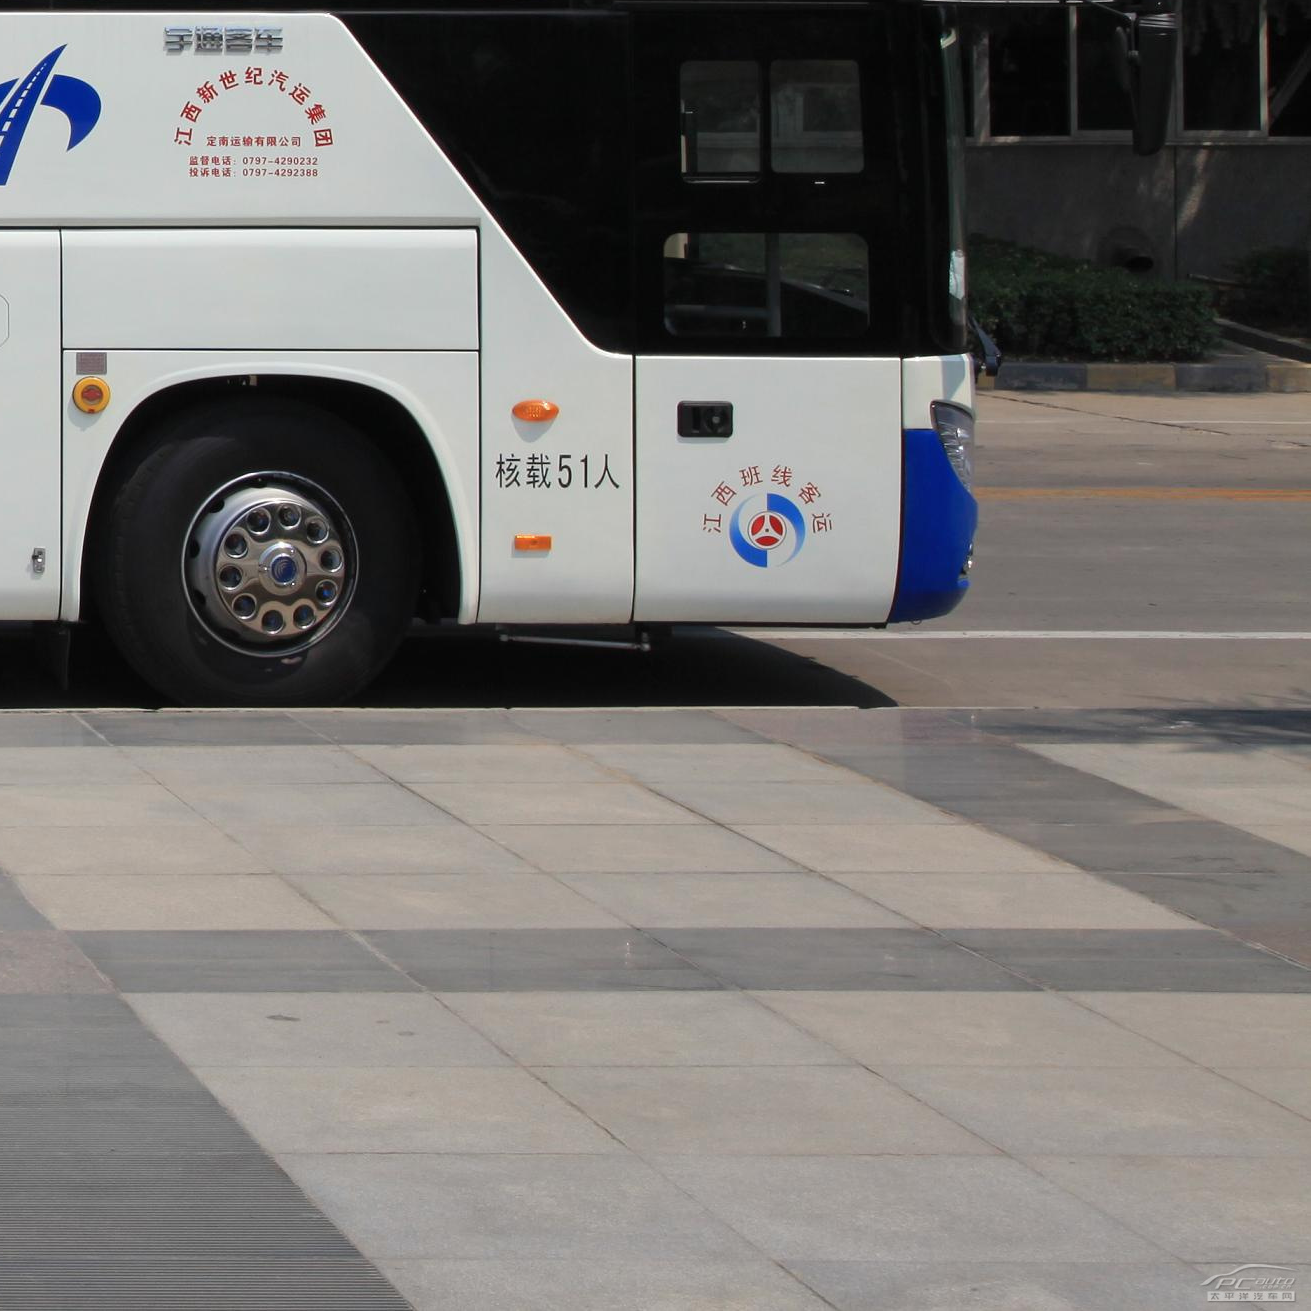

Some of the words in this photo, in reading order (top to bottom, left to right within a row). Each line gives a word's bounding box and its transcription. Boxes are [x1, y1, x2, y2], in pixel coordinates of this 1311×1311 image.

[174, 66, 334, 147] 江西新世纪汽运集团
[206, 135, 301, 147] 定南运输有限公司
[495, 453, 620, 489] 核载51人
[702, 464, 833, 534] 江西班线客运
